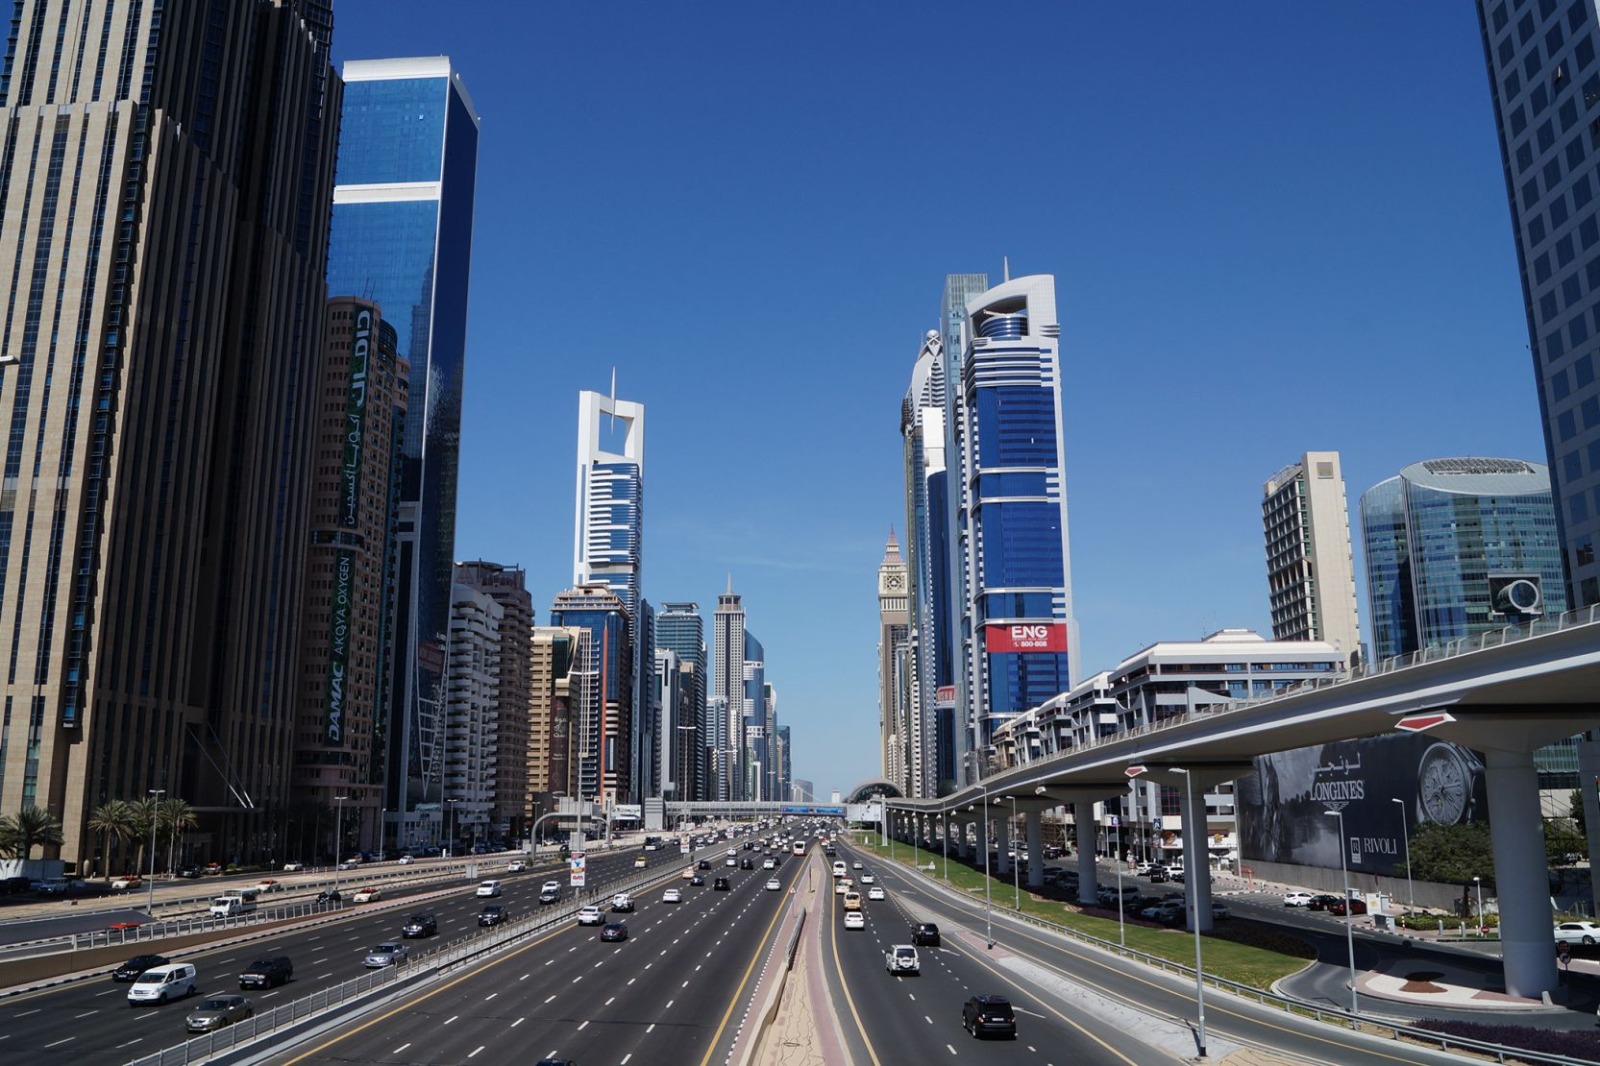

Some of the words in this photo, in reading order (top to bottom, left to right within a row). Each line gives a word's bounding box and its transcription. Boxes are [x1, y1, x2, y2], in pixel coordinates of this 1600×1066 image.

[1012, 625, 1048, 638] ENG
[328, 661, 344, 741] DAMAC
[337, 556, 350, 604] OXYGEN
[1310, 780, 1365, 801] LONGINES
[1363, 837, 1397, 854] RIVOLI
